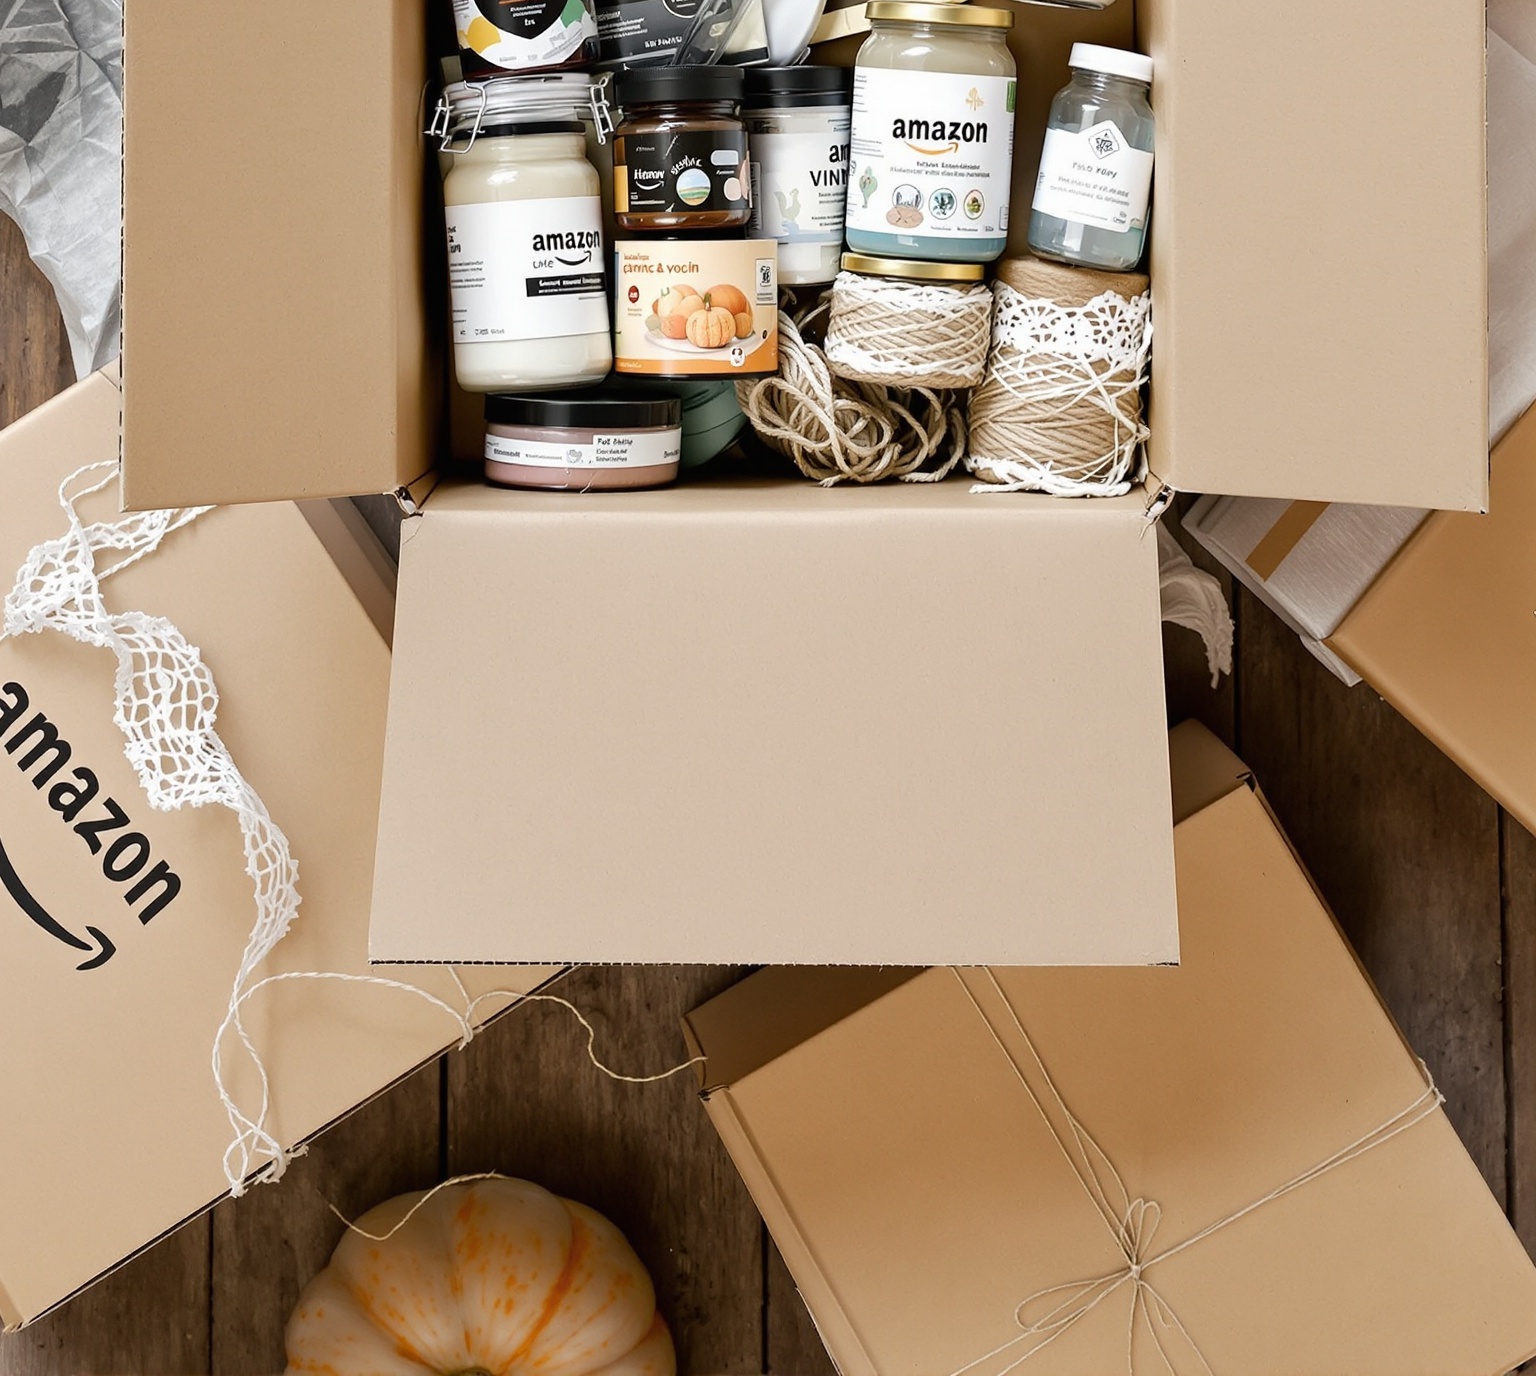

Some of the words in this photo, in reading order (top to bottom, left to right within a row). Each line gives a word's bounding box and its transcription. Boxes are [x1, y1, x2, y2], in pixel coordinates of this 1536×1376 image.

[892, 118, 988, 143] amazon
[532, 230, 600, 252] amazon
[0, 681, 182, 926] amazon
